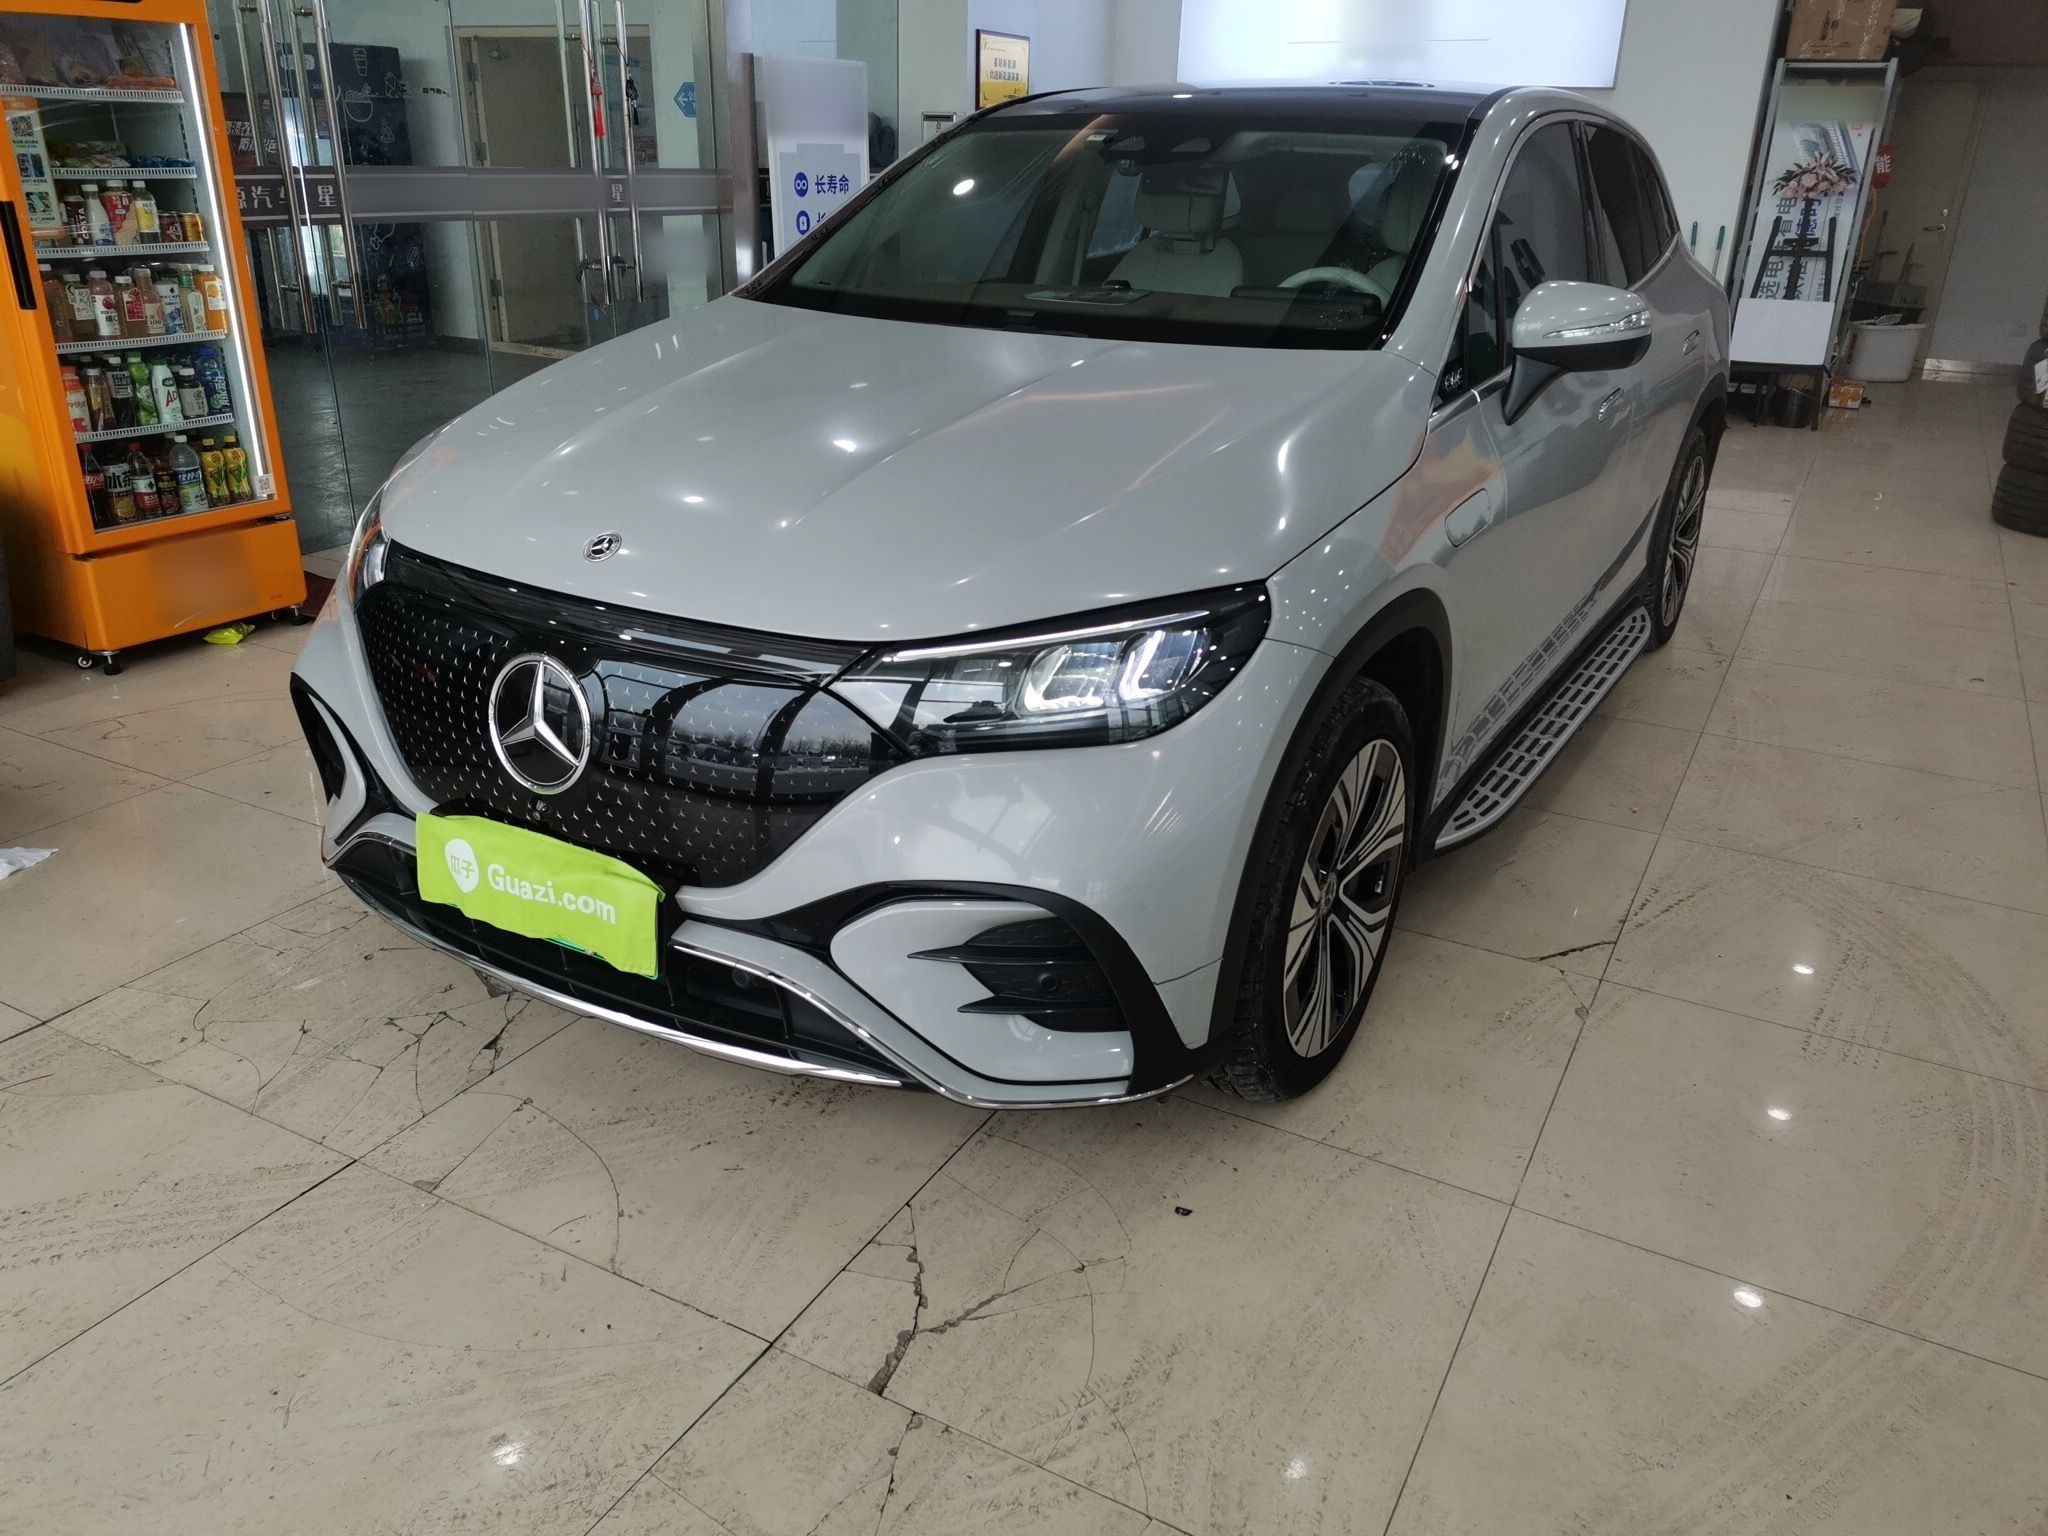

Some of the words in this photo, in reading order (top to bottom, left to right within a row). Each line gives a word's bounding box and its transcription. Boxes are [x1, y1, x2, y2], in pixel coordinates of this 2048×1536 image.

[611, 184, 625, 203] 星
[815, 174, 849, 195] 长寿命
[318, 185, 336, 207] 星
[449, 854, 476, 880] 瓜子
[487, 863, 617, 925] Guazi.com
